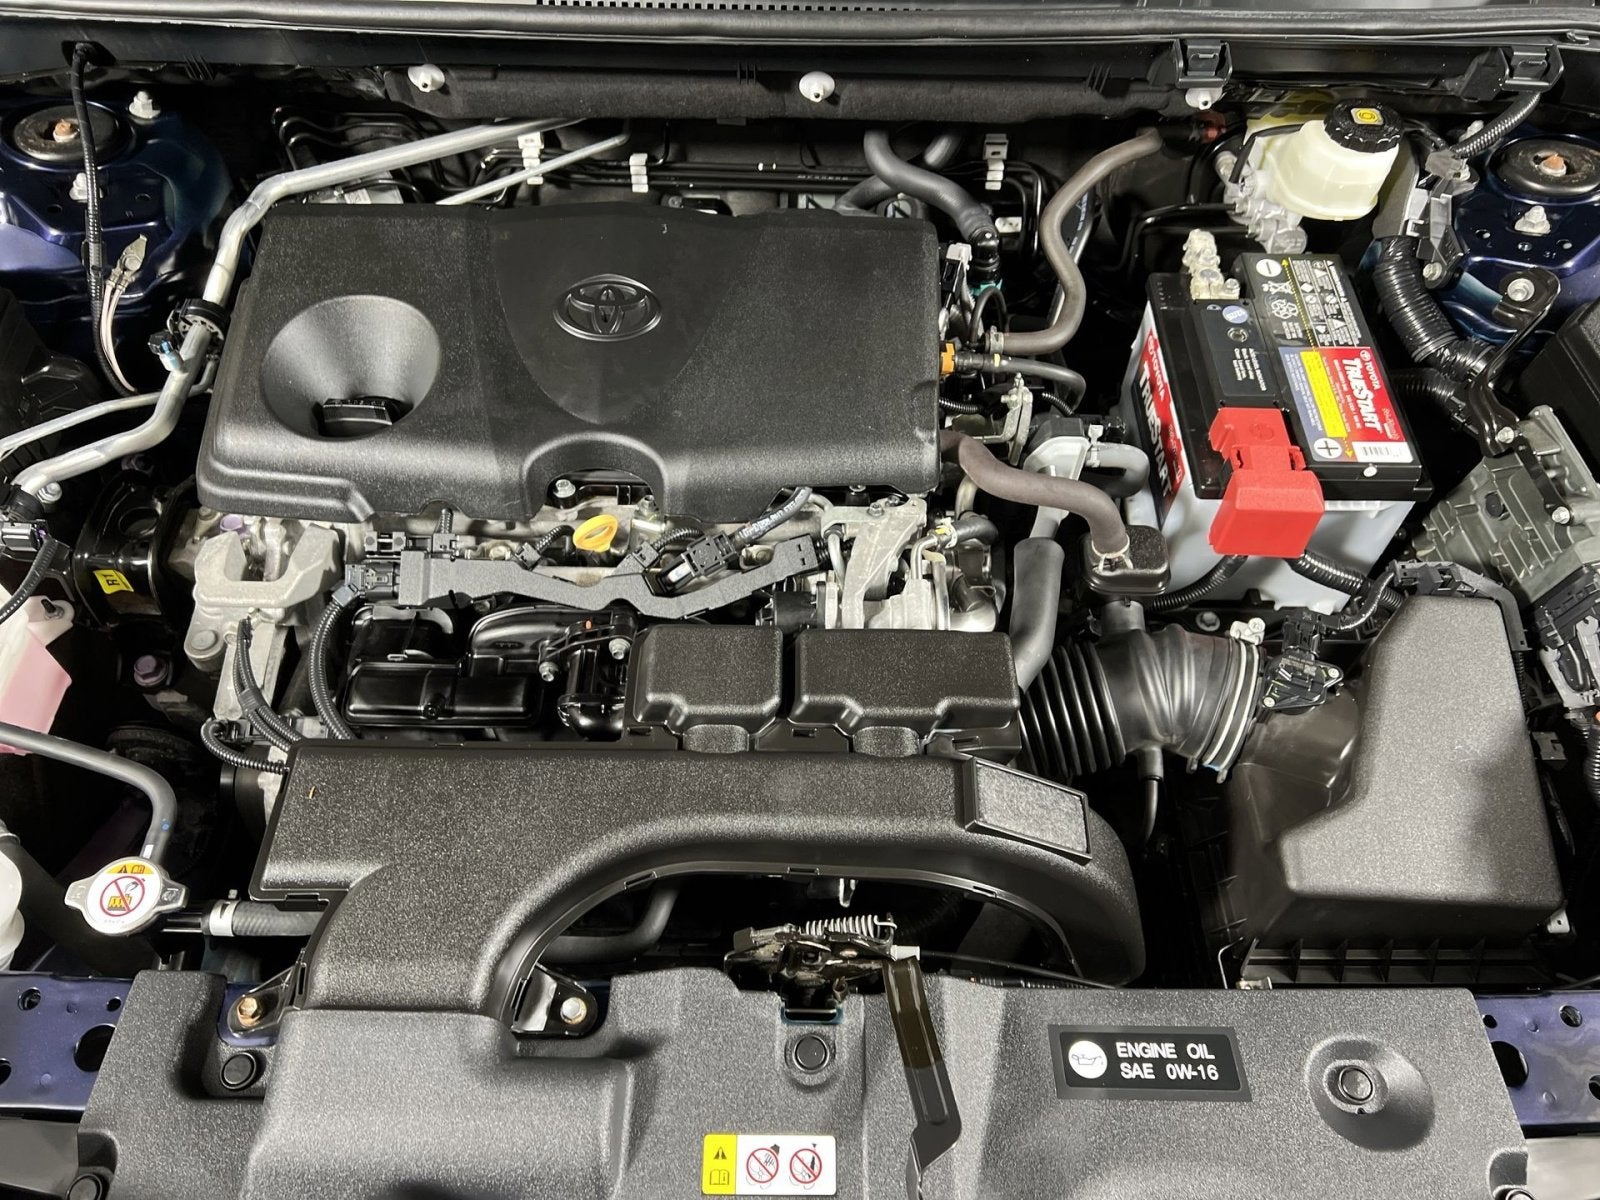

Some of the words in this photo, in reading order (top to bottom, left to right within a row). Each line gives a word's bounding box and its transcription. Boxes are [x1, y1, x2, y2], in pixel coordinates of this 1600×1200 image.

[1364, 361, 1382, 390] TOYOTA
[1115, 1041, 1178, 1059] ENGINE
[1186, 1043, 1216, 1060] OIL
[1119, 1062, 1156, 1080] SAE
[1165, 1063, 1219, 1081] 0W-16
